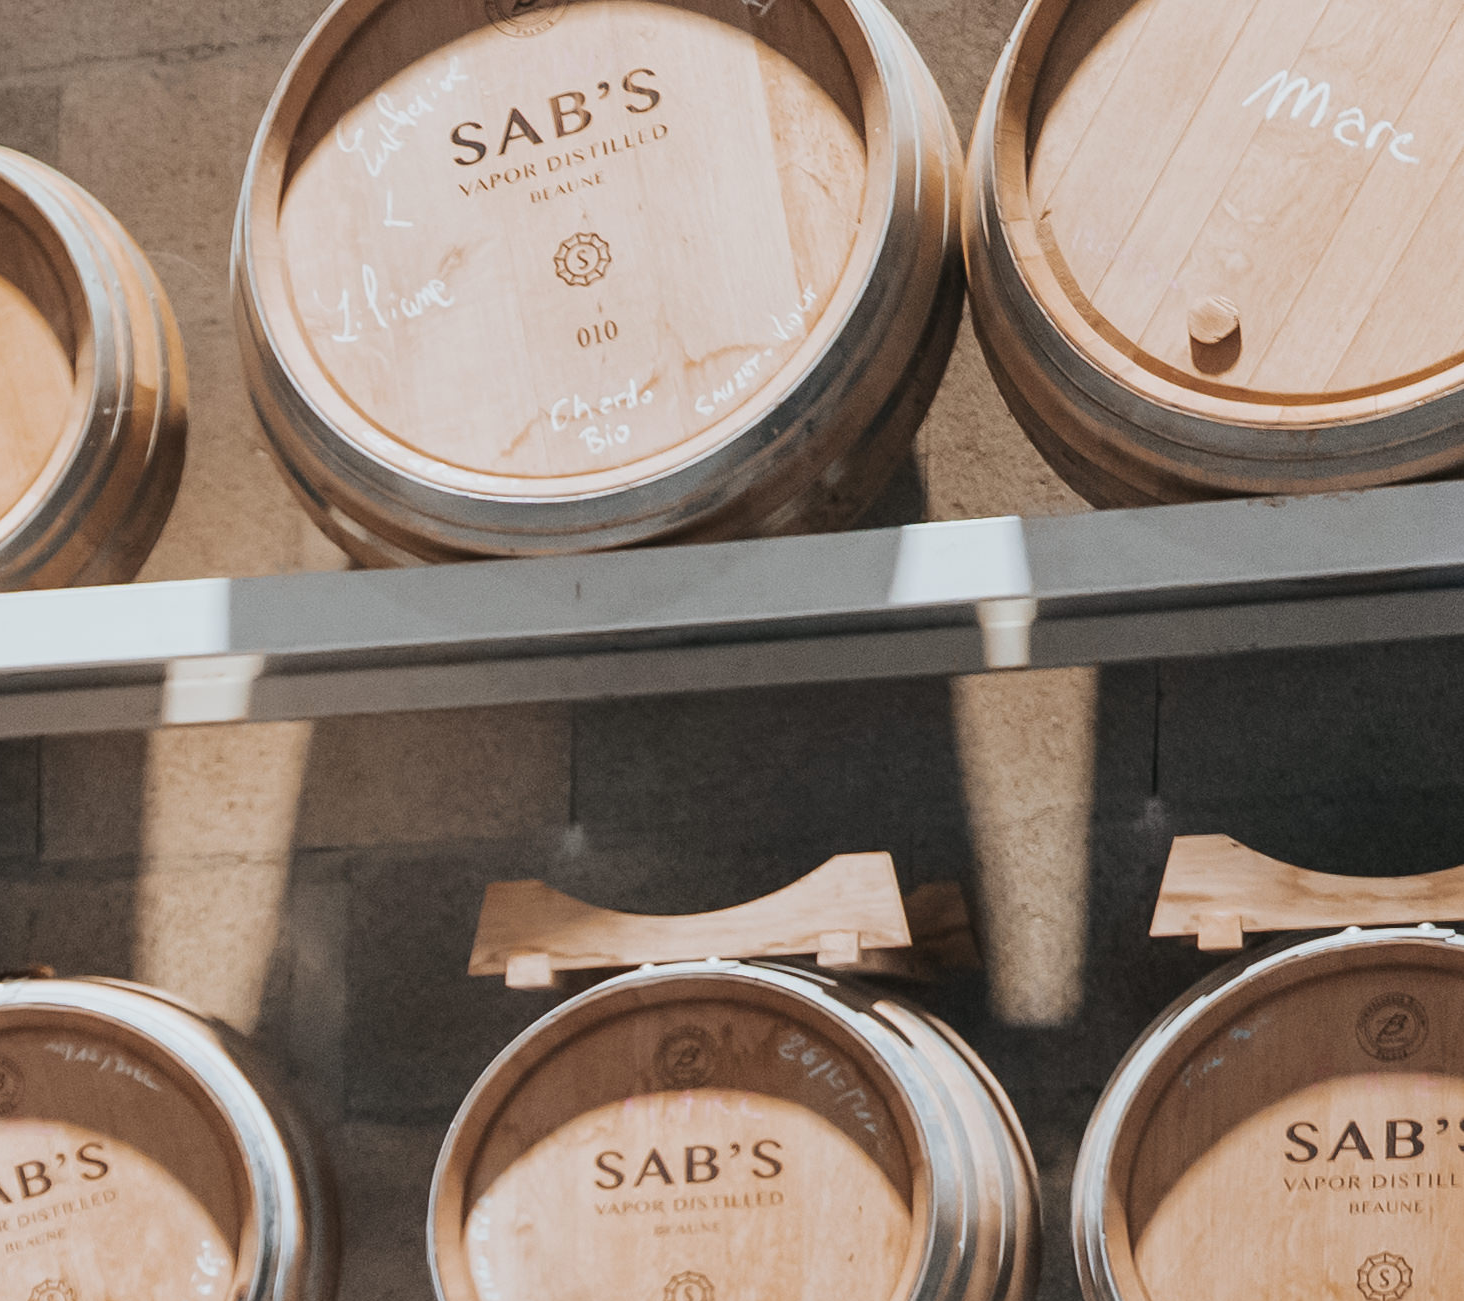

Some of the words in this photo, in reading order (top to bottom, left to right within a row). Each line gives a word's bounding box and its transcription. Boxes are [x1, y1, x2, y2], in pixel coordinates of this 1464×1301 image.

[450, 67, 661, 166] SAB'S
[1241, 68, 1421, 165] Marc
[458, 162, 537, 198] VAPOR
[546, 123, 669, 174] DISTILLED
[529, 169, 606, 204] BEAUNE
[577, 320, 619, 349] 010
[1283, 1117, 1464, 1164] SAB'
[594, 1138, 784, 1191] SAB'S
[1282, 1174, 1361, 1193] VAPOR
[16, 1188, 118, 1229] DISTILLED
[594, 1199, 666, 1217] VAPOR
[673, 1190, 785, 1213] DISTILLED
[1347, 1199, 1424, 1216] BEAUNE
